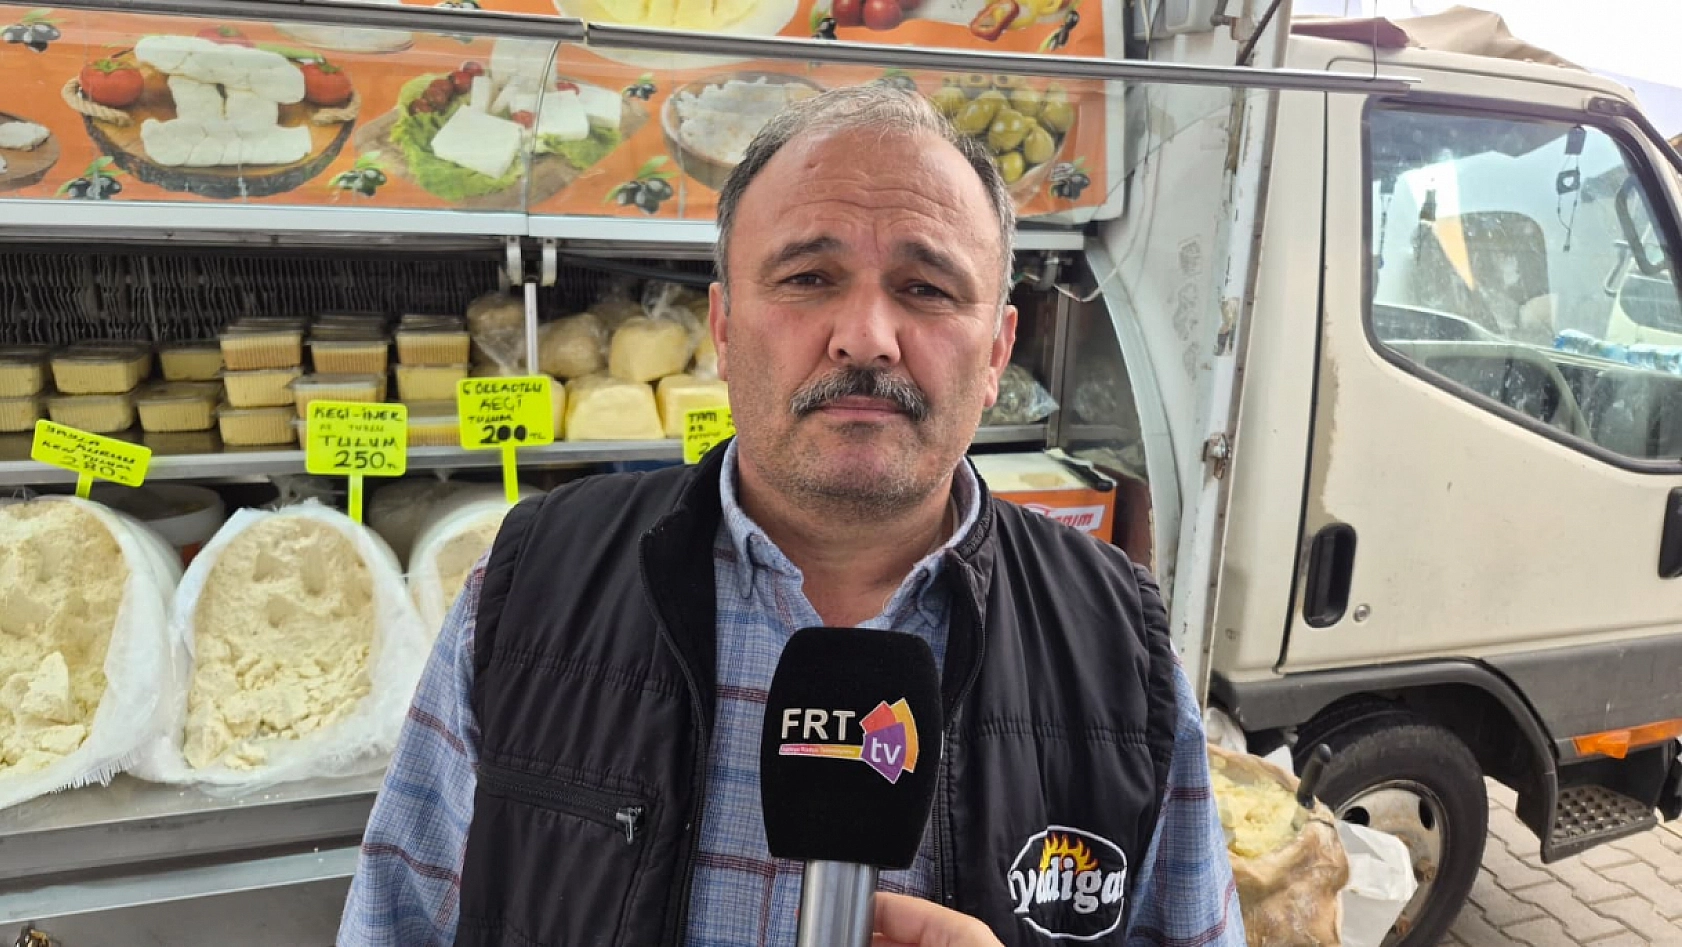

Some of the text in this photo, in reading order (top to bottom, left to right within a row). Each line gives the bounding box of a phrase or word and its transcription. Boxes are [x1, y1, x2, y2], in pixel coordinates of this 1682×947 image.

[317, 435, 400, 450] TULUM
[781, 707, 856, 741] FRT
[870, 737, 903, 765] tv
